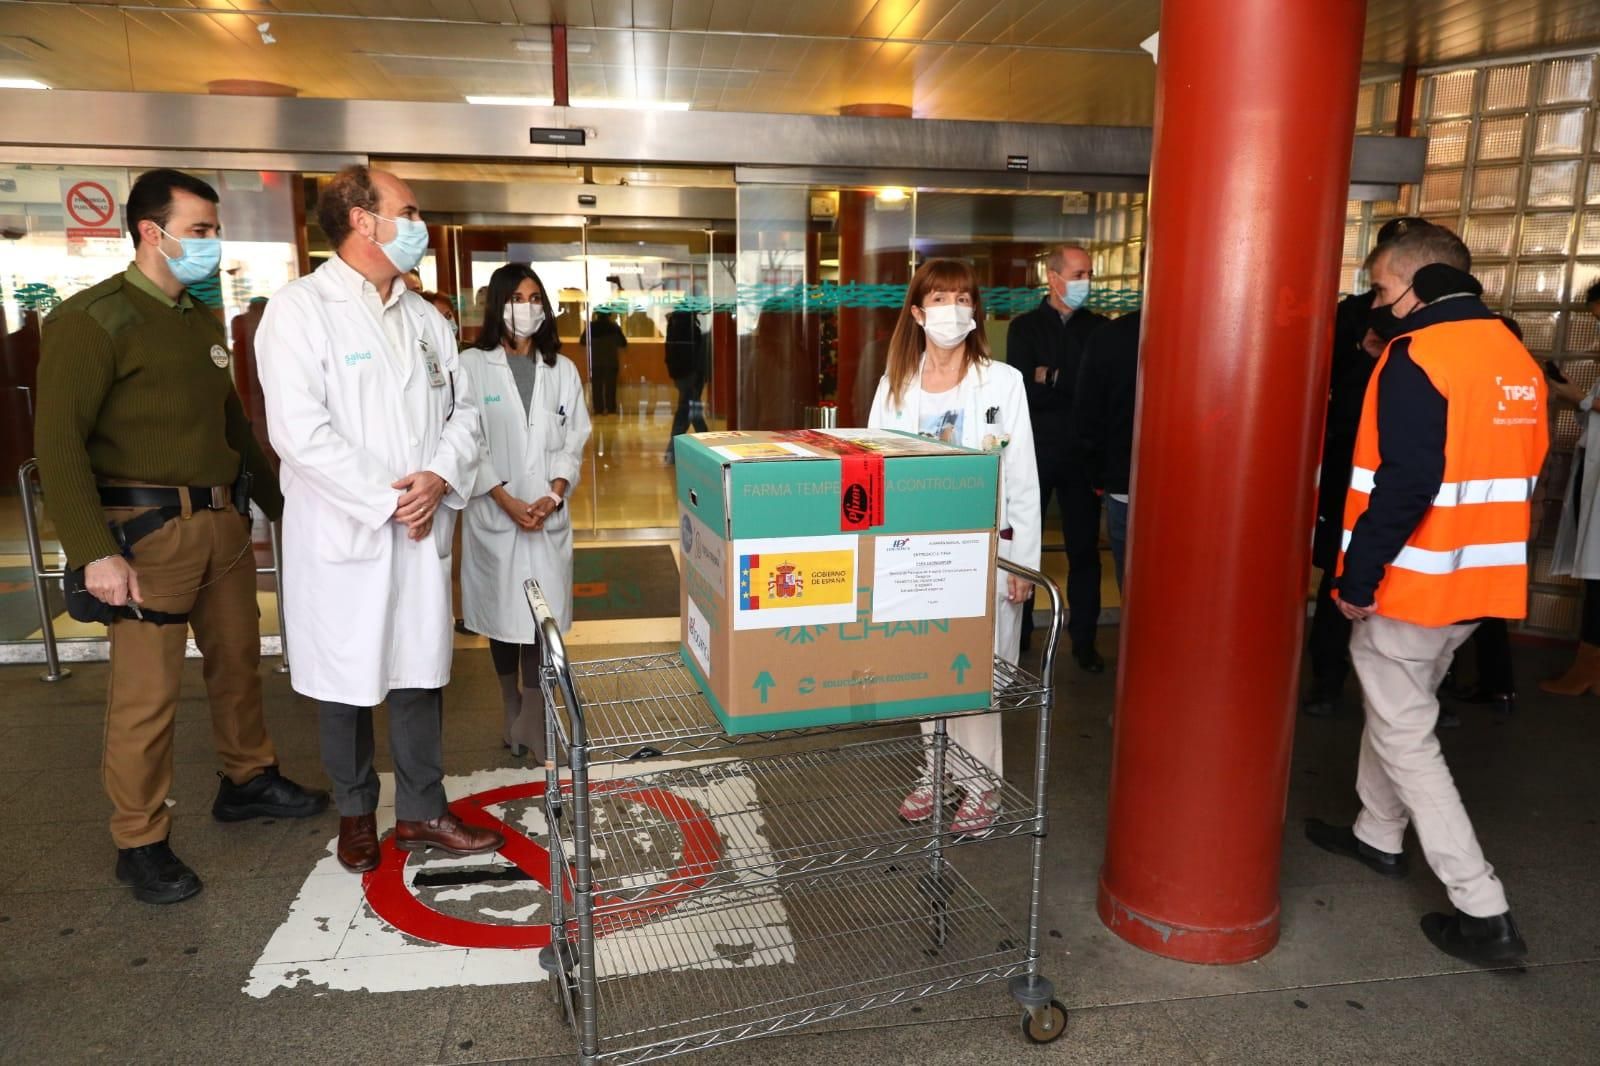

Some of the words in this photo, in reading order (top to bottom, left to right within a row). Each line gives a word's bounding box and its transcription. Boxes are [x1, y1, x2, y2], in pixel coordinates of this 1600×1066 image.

[1501, 385, 1536, 401] TIPSA
[743, 483, 792, 497] FARMA
[896, 476, 984, 493] CONTROLADA
[811, 570, 846, 578] GOBIERNO
